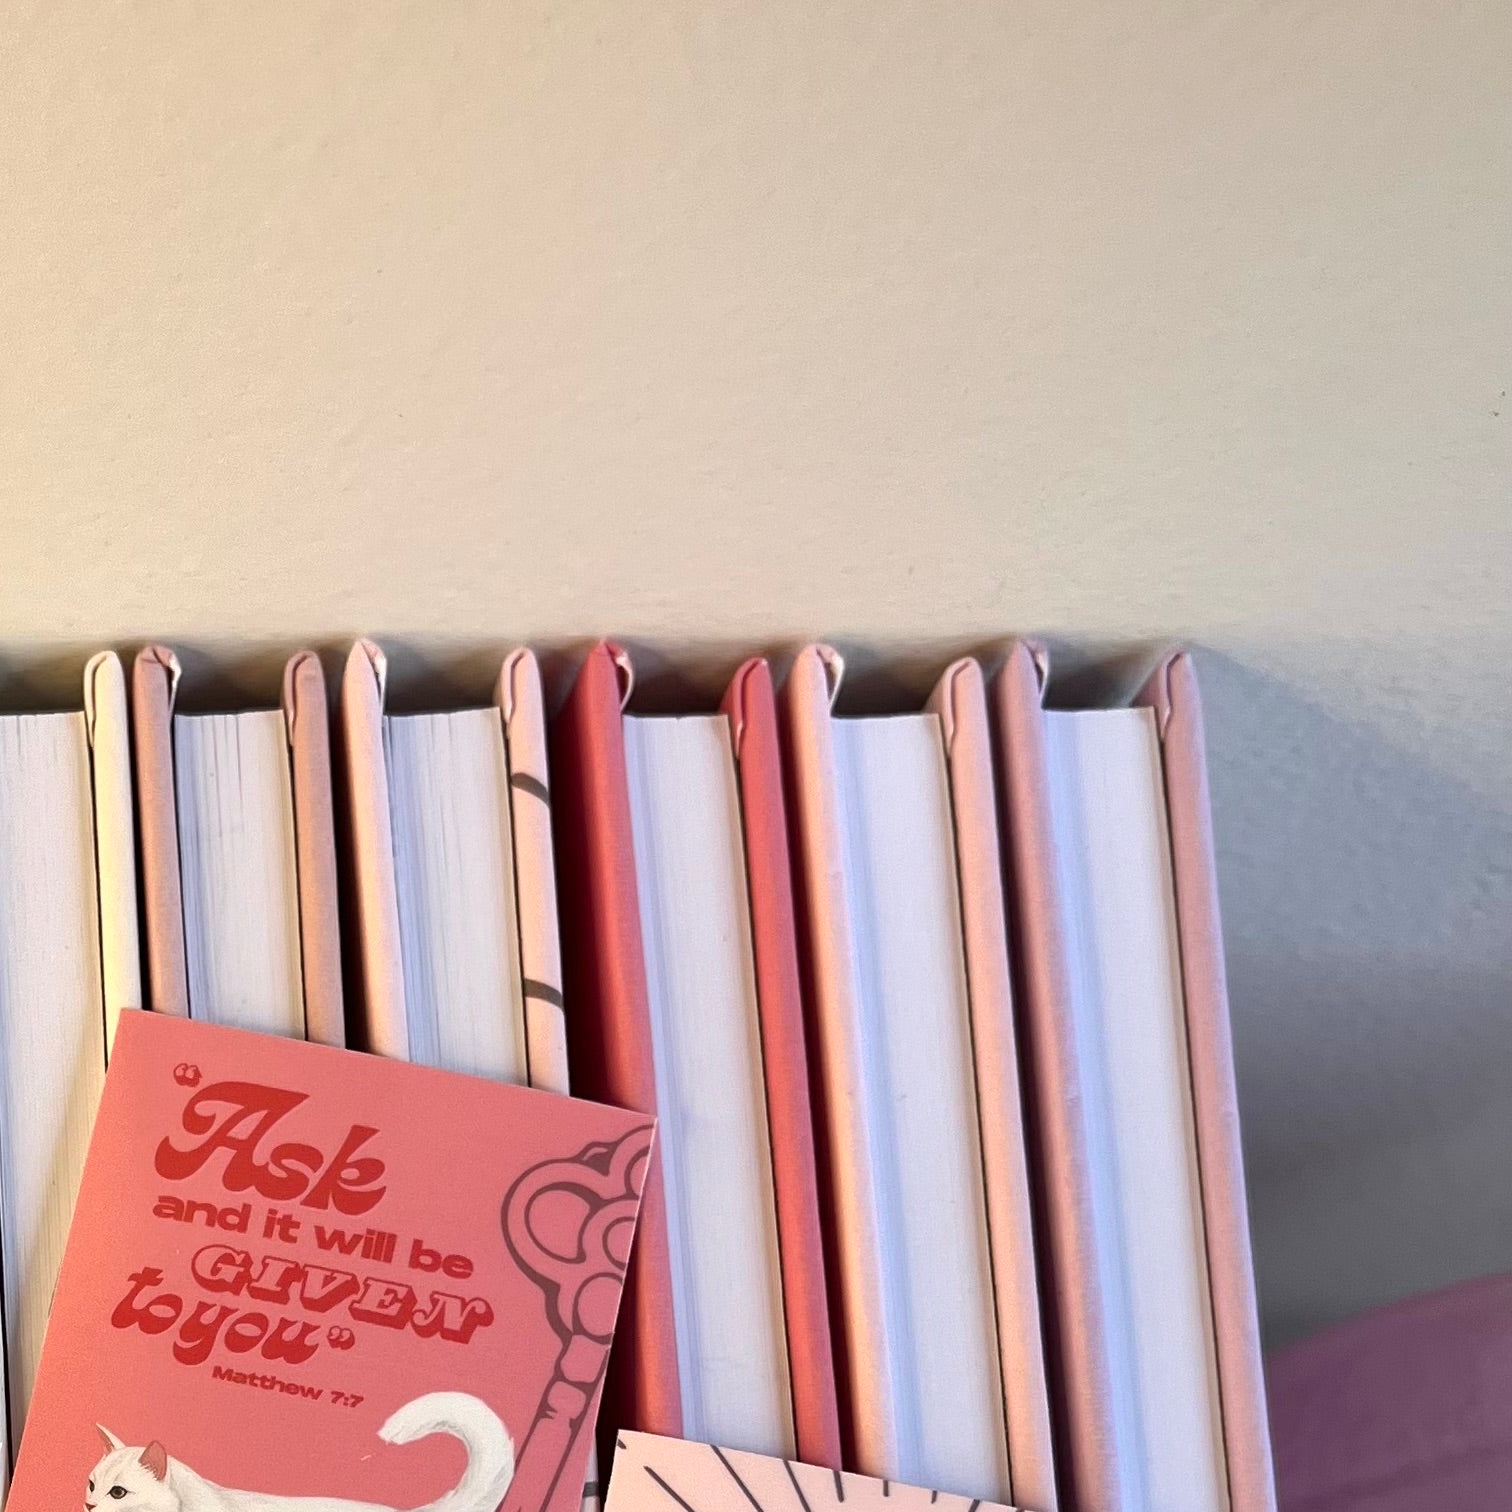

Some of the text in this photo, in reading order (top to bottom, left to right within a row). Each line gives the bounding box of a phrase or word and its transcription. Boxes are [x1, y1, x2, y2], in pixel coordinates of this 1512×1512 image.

[152, 1195, 474, 1279] and it will be
[191, 1244, 495, 1345] GIVEN
[211, 1366, 365, 1409] Matthew 7:7
